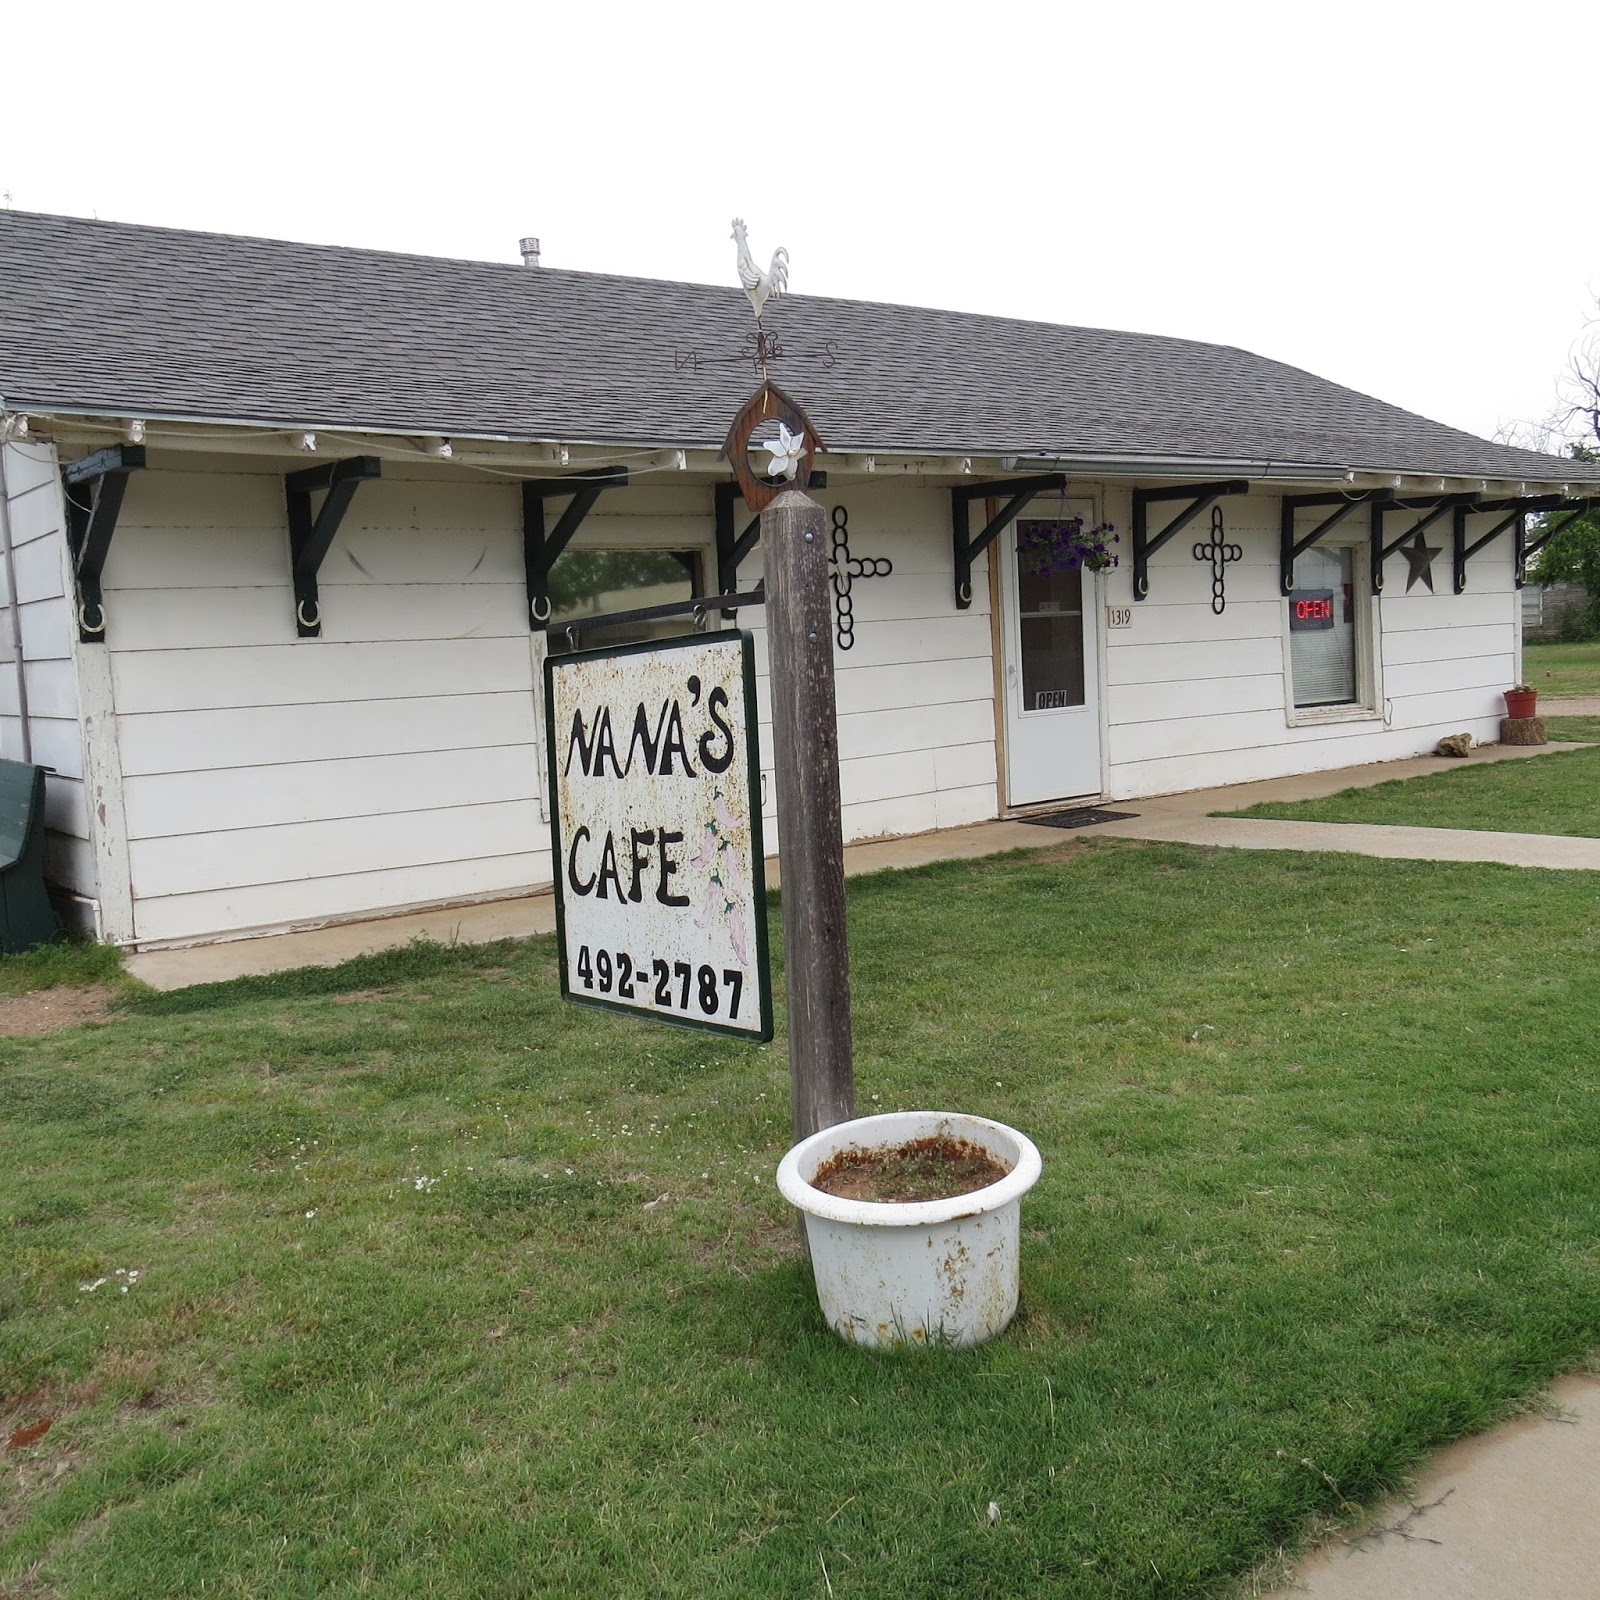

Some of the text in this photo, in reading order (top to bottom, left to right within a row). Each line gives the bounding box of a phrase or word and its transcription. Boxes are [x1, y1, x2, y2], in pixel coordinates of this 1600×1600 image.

[1111, 609, 1131, 626] 1319
[1296, 600, 1330, 618] OPEN
[1038, 691, 1066, 708] OPEN
[564, 675, 734, 779] NANA'S
[568, 826, 690, 907] CAFE
[577, 945, 743, 1020] 492-2787
